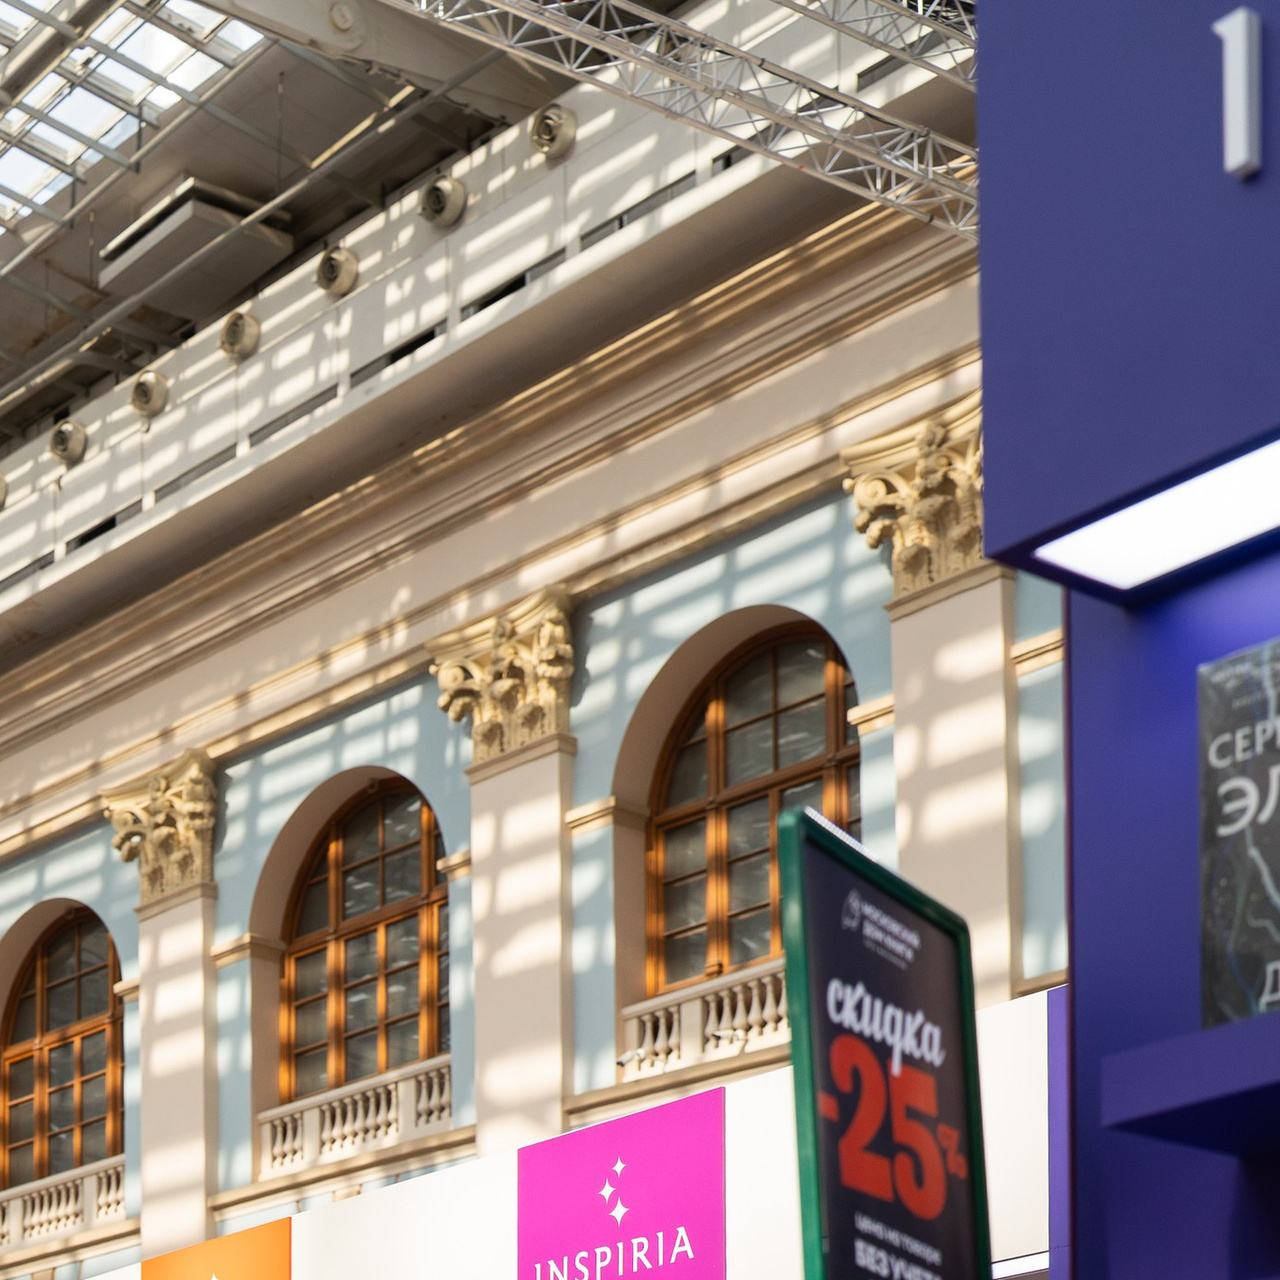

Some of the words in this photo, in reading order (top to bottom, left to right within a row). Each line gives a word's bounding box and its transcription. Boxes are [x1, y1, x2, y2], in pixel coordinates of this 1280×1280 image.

[827, 978, 946, 1077] скидка
[818, 1034, 968, 1221] -25%
[854, 1238, 890, 1278] БЕЗ
